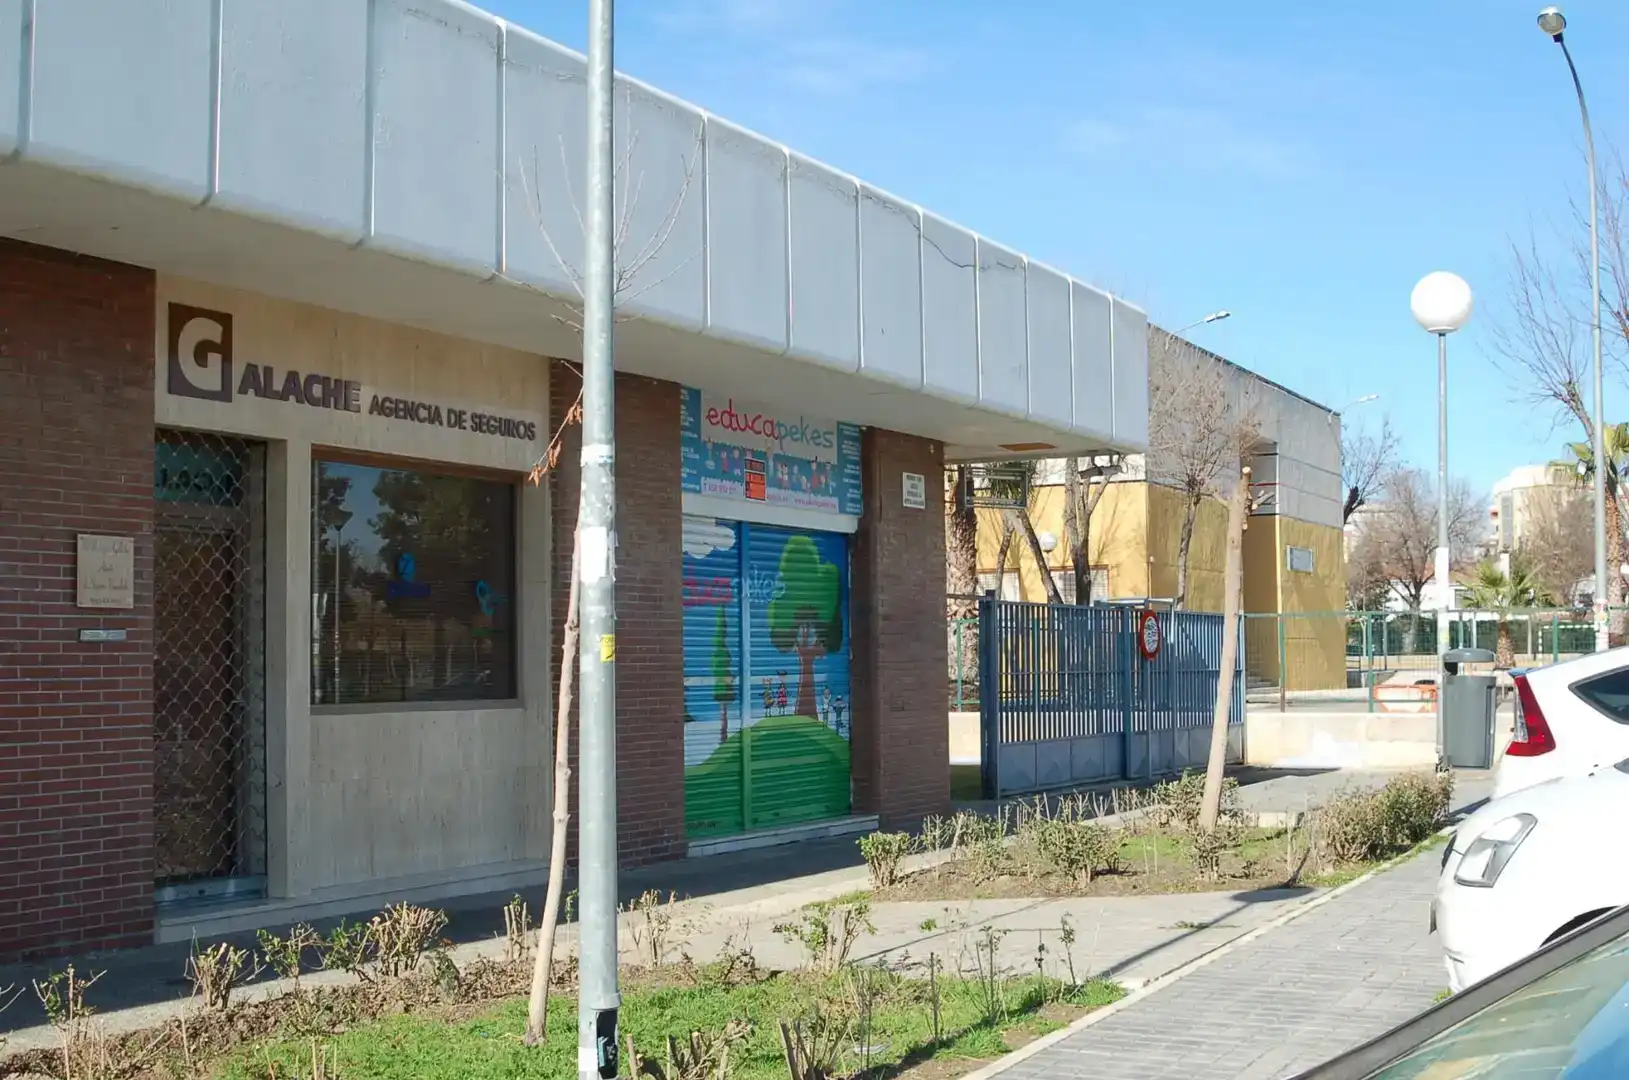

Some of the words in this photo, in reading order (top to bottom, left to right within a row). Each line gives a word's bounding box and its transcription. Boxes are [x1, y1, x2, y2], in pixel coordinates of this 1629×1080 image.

[368, 394, 443, 427] AGENCIA
[447, 407, 467, 430] DE
[470, 412, 536, 441] SEGUROS
[705, 398, 835, 451] educapekes
